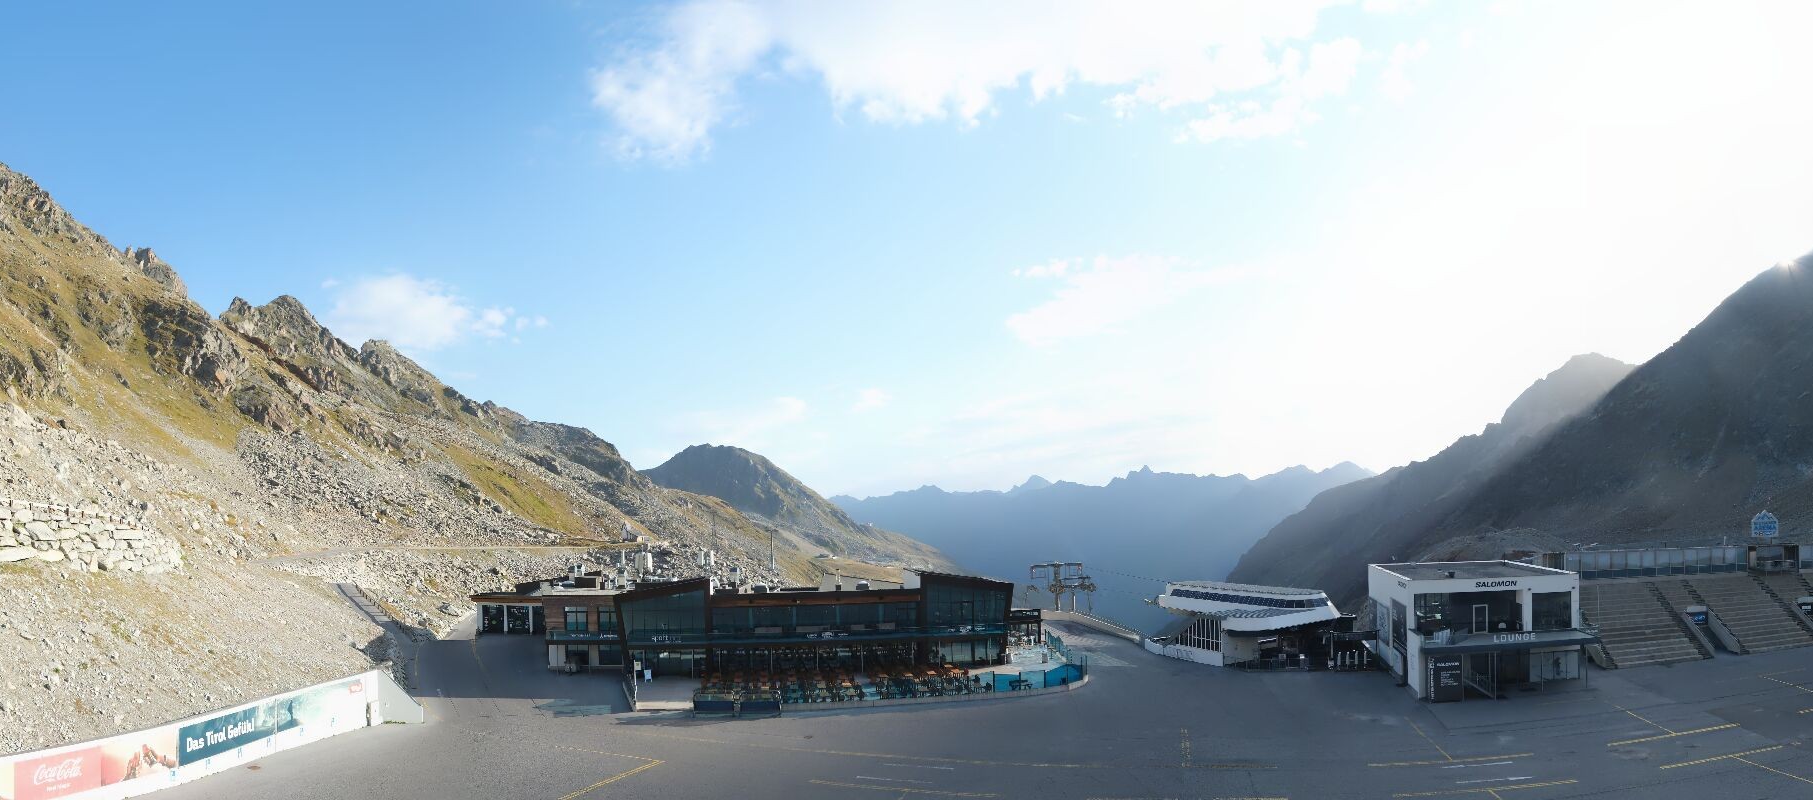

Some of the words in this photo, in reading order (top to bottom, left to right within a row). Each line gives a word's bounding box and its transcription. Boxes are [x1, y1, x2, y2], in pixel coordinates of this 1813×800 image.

[1475, 580, 1518, 588] SALOMON
[1493, 632, 1536, 643] LOUNGE
[186, 737, 205, 753] Das
[205, 726, 226, 746] Tirol
[228, 717, 255, 740] Gefühl
